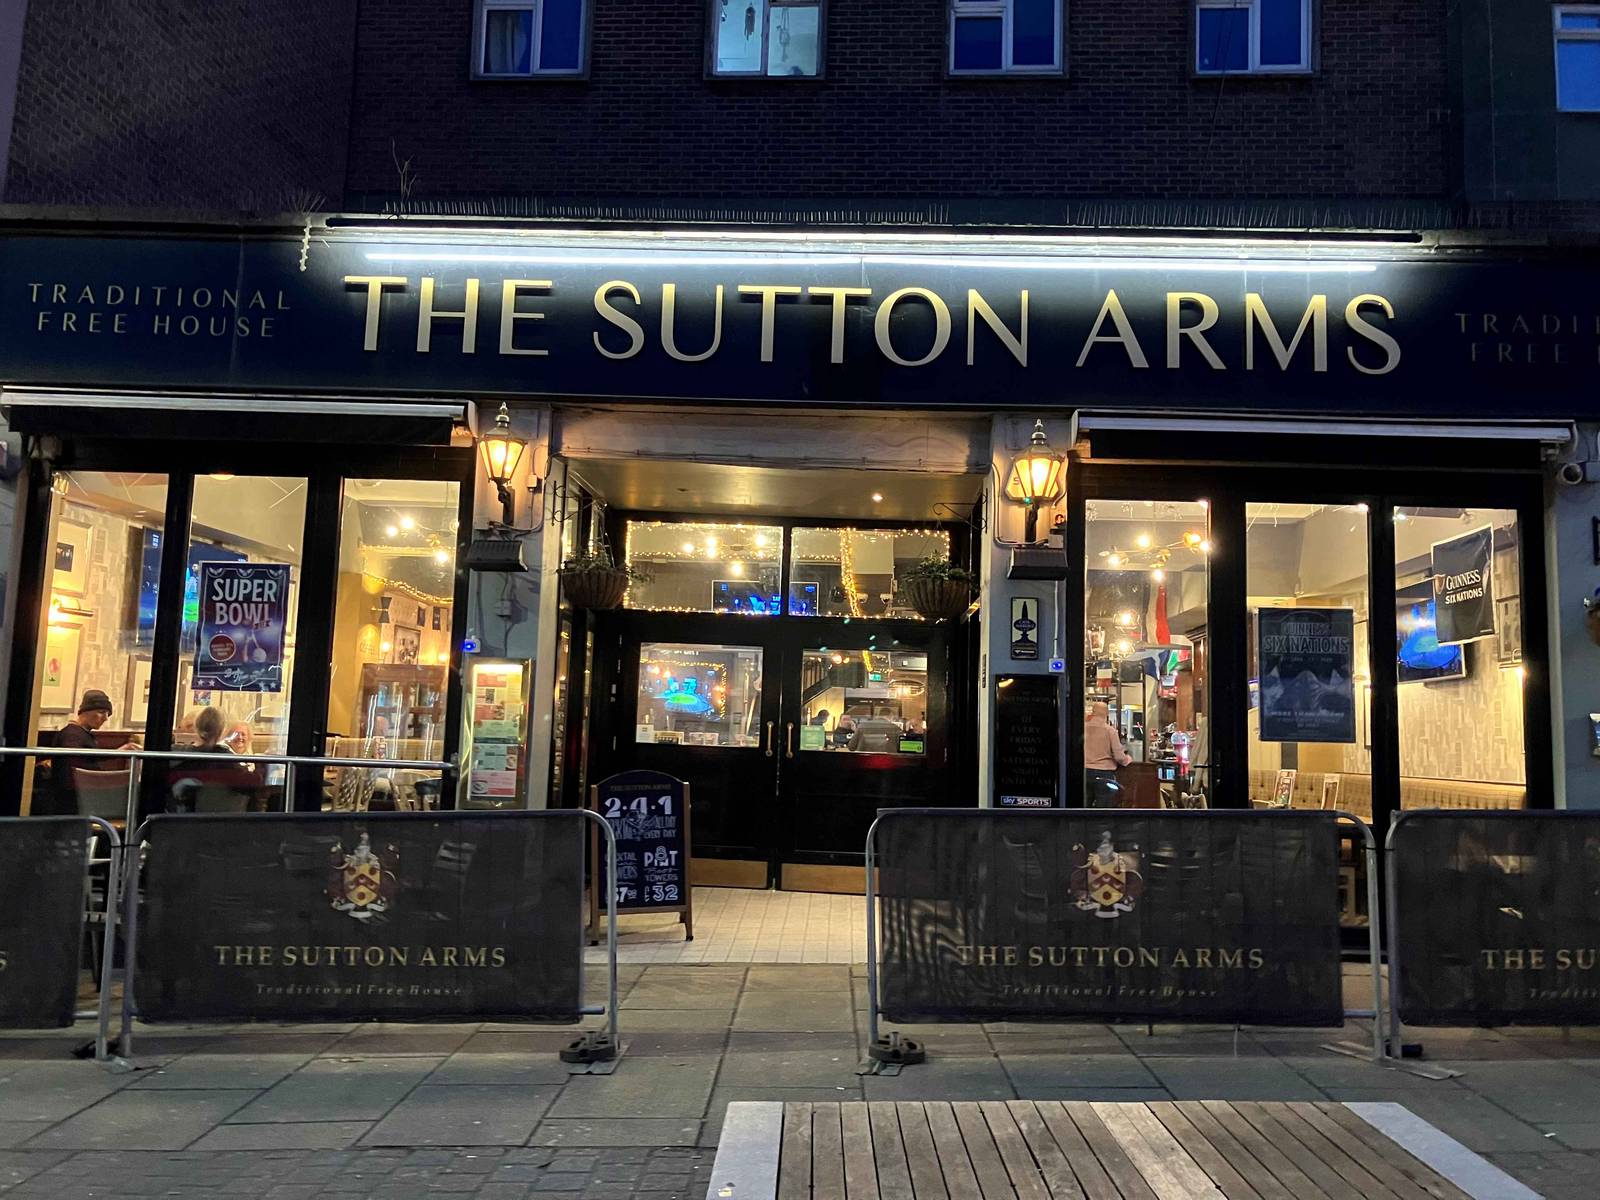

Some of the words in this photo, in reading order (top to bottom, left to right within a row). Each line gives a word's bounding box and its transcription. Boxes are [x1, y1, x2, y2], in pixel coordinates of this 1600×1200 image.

[28, 282, 291, 311] TRADITIONAL
[37, 310, 128, 333] FREE
[153, 313, 275, 338] HOUSE
[344, 276, 553, 356] THE
[592, 280, 1029, 368] SUTTON
[1076, 289, 1402, 375] ARMS
[1454, 312, 1600, 335] TRADI
[212, 578, 278, 602] SUPER
[1446, 569, 1481, 590] GUINNESS
[215, 602, 271, 626] BOWL
[1289, 635, 1349, 654] NATIONS
[1017, 798, 1049, 806] SPORTS
[214, 946, 272, 967] THE
[283, 946, 410, 967] SUTTON
[421, 946, 507, 968] ARMS
[959, 946, 1017, 968] THE
[1028, 946, 1160, 968] SUTTON
[1172, 947, 1265, 969] ARMS
[1481, 948, 1546, 969] THE
[256, 983, 361, 996] Traditional
[367, 983, 402, 996] Free
[409, 983, 462, 996] House
[1001, 983, 1112, 997] Traditional
[1118, 985, 1156, 997] Free
